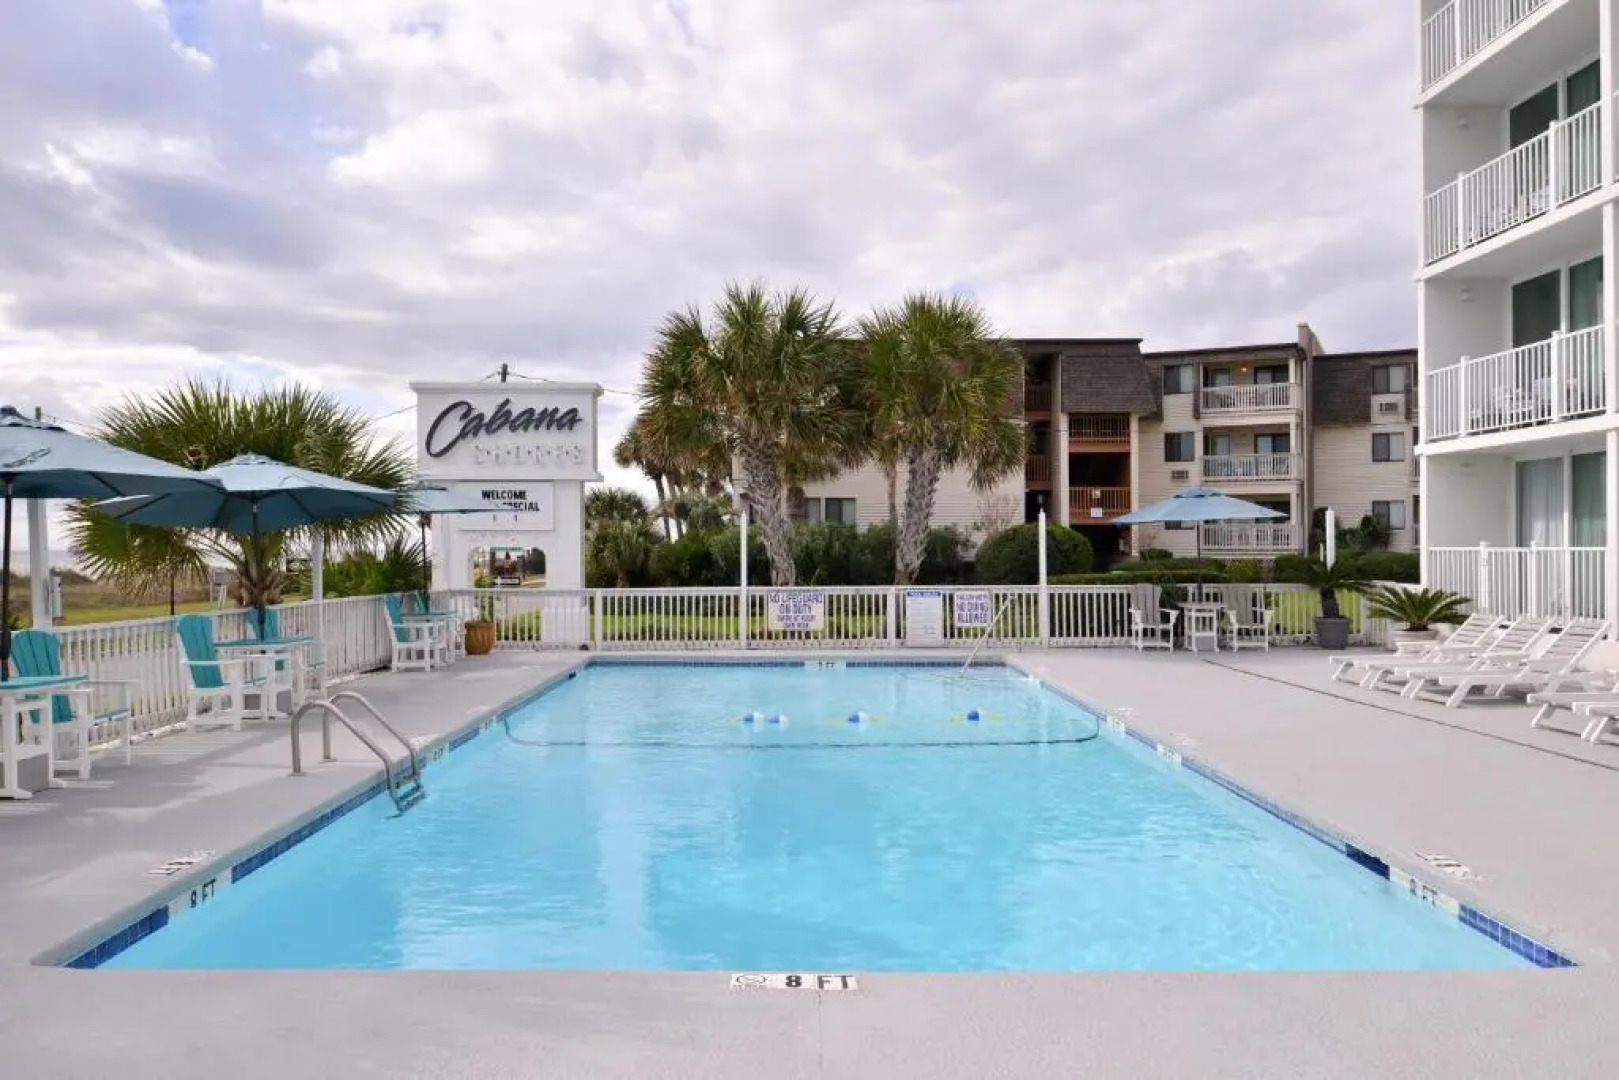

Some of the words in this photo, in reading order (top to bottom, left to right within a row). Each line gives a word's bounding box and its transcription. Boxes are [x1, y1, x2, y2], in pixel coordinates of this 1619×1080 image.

[425, 398, 582, 457] Cabana
[481, 489, 526, 500] WELCOME
[782, 592, 823, 603] LIFEGUARD
[793, 603, 811, 614] DUTY
[957, 612, 988, 624] ALLOWED
[202, 878, 216, 903] FT
[1422, 884, 1438, 907] FT
[785, 975, 802, 988] 8
[817, 975, 854, 989] FT
